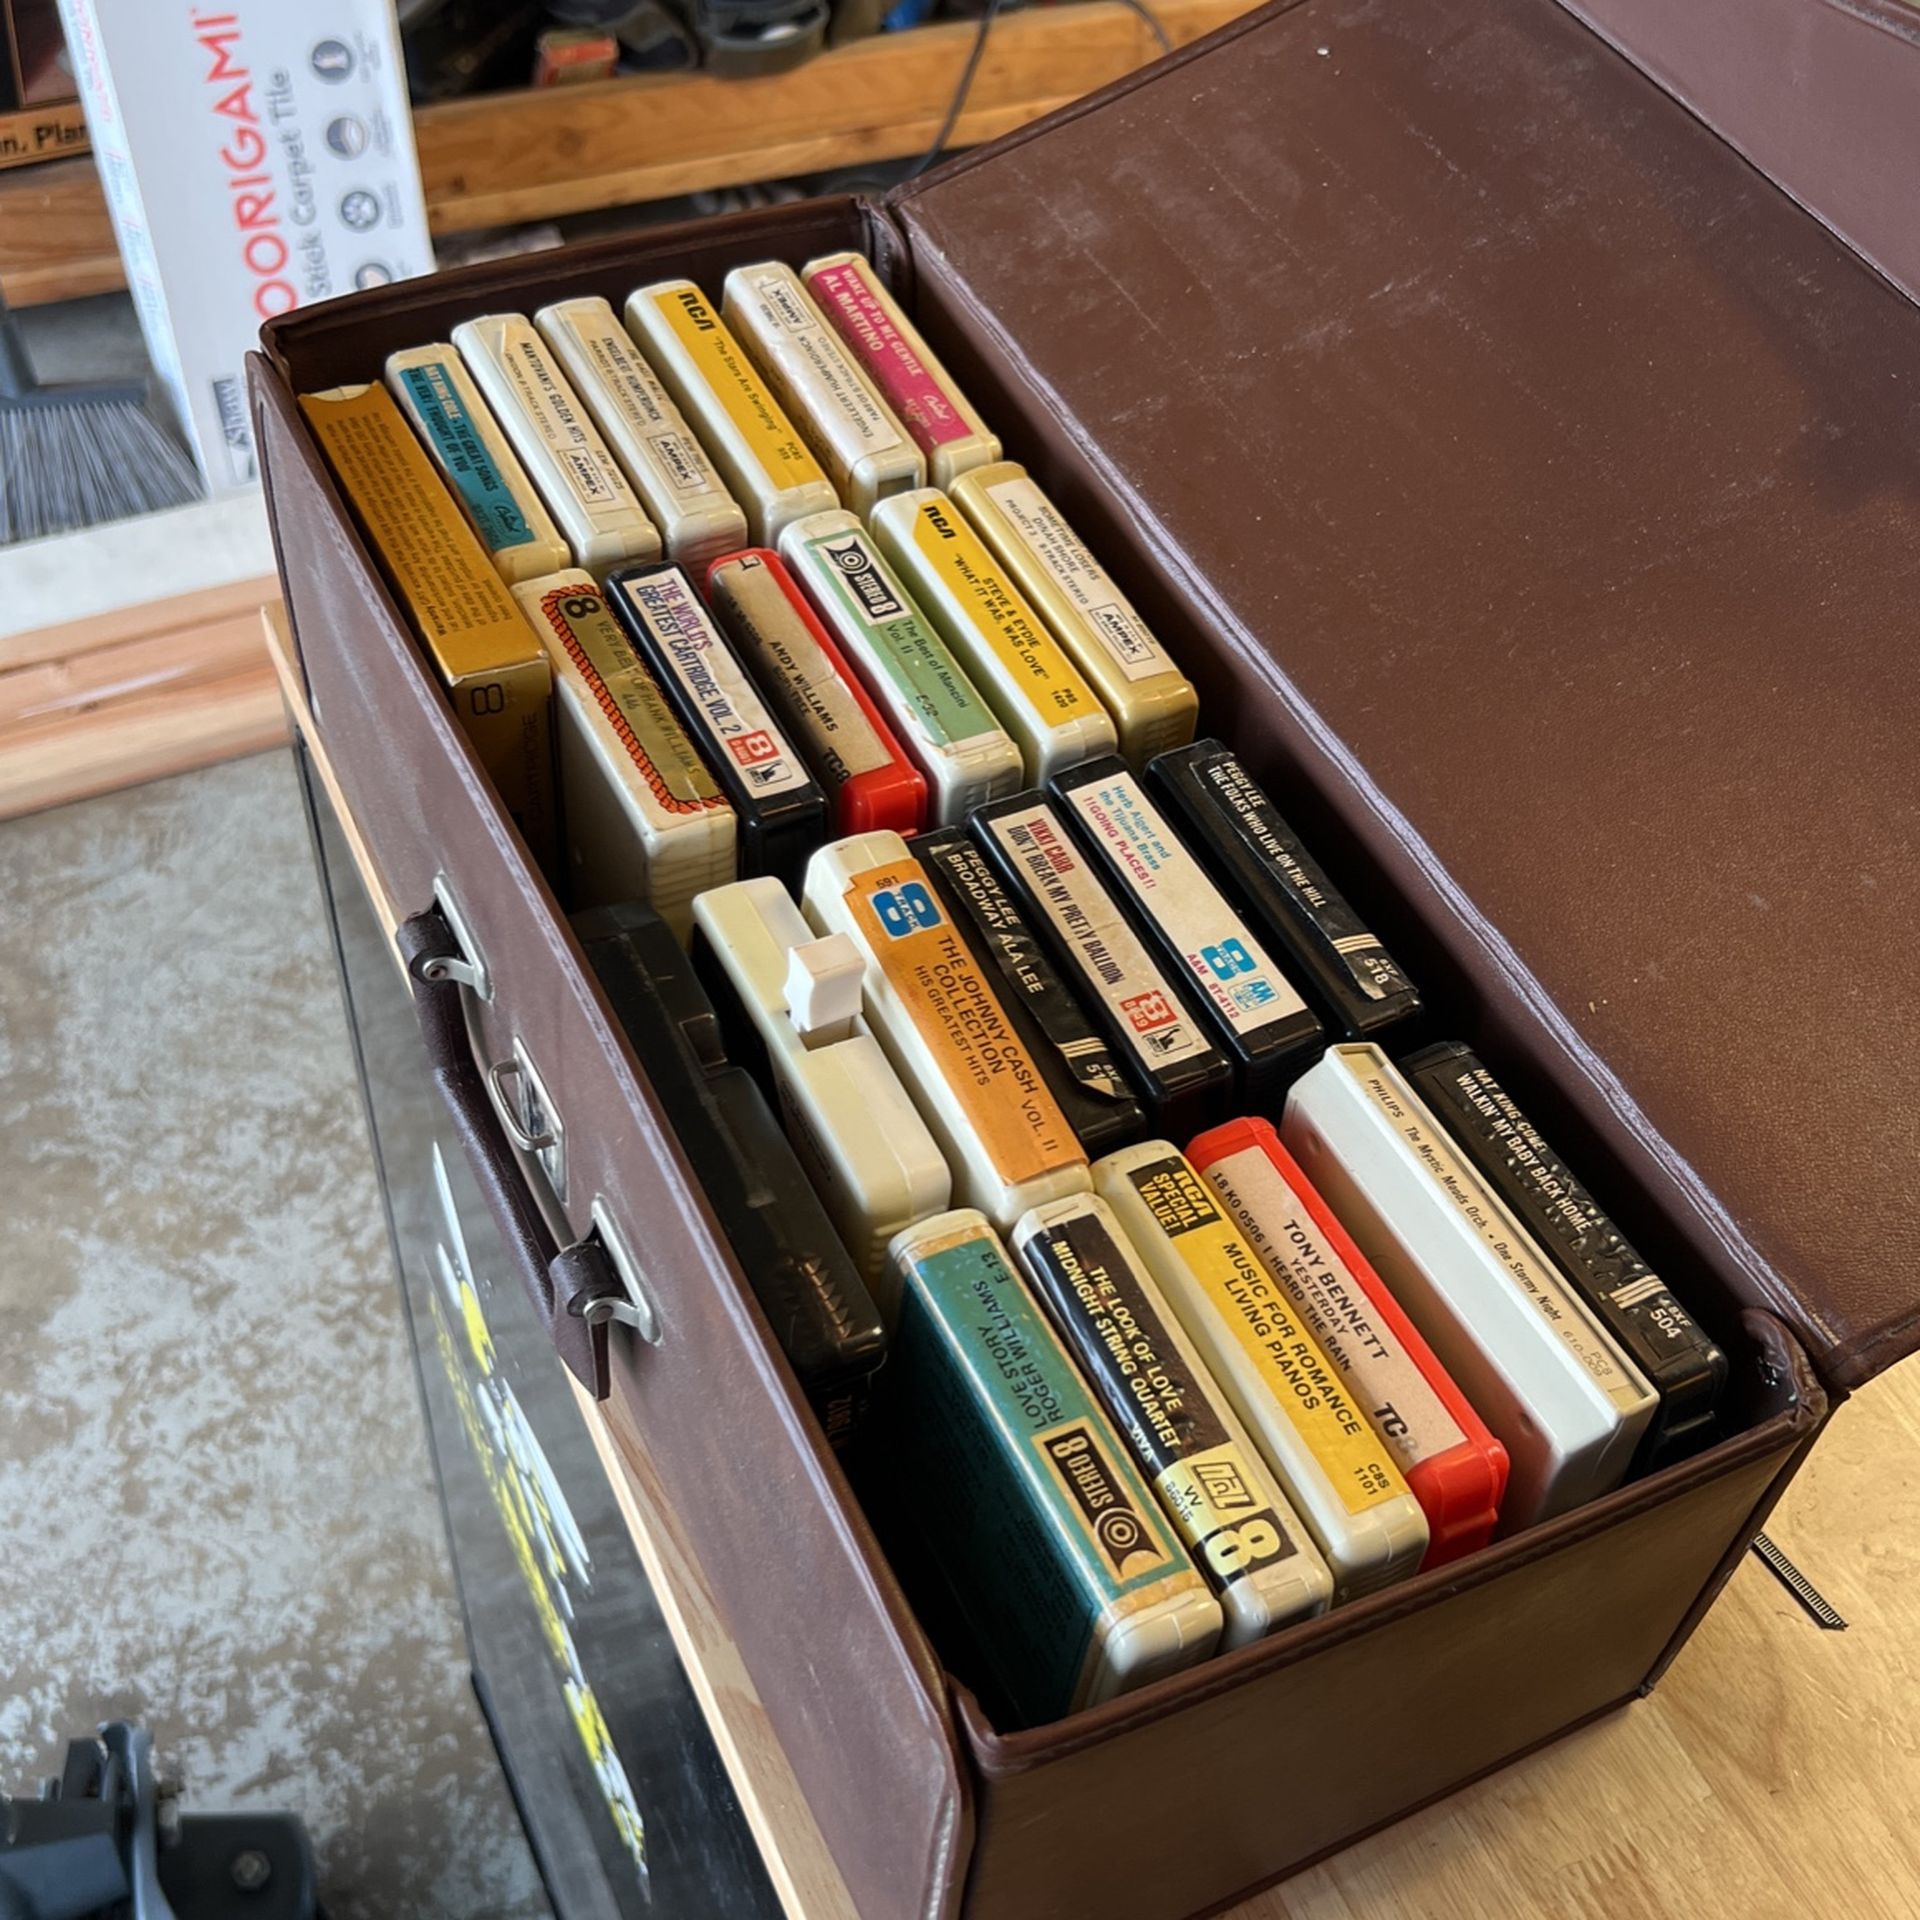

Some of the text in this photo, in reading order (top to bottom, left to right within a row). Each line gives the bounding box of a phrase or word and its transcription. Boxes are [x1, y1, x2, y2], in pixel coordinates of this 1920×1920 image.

[264, 69, 292, 124] Tile
[284, 130, 316, 227] Carpet
[677, 290, 716, 332] RCA
[772, 288, 801, 324] AMPEX
[821, 273, 886, 351] AL MARTINO
[840, 269, 866, 295] WAKE
[859, 296, 876, 310] UP
[869, 311, 885, 323] TO
[722, 355, 743, 377] Stars
[737, 377, 753, 392] Are
[548, 393, 574, 423] GOLDEN
[566, 426, 587, 444] HITS
[570, 456, 600, 494] AMPEX
[660, 441, 691, 479] AMPEX
[923, 505, 957, 540] RCA
[1031, 517, 1059, 544] DINAH
[1052, 545, 1081, 573] SHORE
[1061, 575, 1089, 604] STEREO
[1069, 548, 1101, 580] LOSERS
[565, 598, 598, 619] 8
[634, 583, 684, 639] GREATEST
[655, 579, 715, 652] THE WORLD'S
[851, 572, 898, 615] STEREO 8
[973, 586, 988, 597] IT
[1001, 624, 1025, 648] WAS
[982, 576, 1040, 648] STEVE & EYDIE
[1102, 612, 1140, 654] AMPEX
[596, 620, 621, 649] VERY
[629, 676, 648, 692] OF
[640, 693, 667, 723] HANK
[768, 640, 838, 731] ANDY WILLIAMS
[900, 619, 970, 708] The Best of Mancini
[704, 698, 736, 725] VOL.
[718, 722, 743, 736] 2
[746, 733, 771, 757] 8
[1221, 761, 1265, 807] PEGGY LEE
[1026, 818, 1075, 874] VIKKI CARR
[1097, 790, 1163, 871] the Tijuana Brass
[1111, 785, 1135, 808] Herb
[1150, 839, 1171, 858] and
[1205, 765, 1327, 907] THE FOLKS WHO LIVE ON THE HILL
[963, 849, 1021, 924] PEGGY LEE
[1006, 824, 1125, 985] DON'T BREAK MY BALLOON
[946, 853, 1045, 993] BROADWAY ALA LEE
[1185, 952, 1208, 975] A&M
[1200, 937, 1257, 981] 8
[1359, 957, 1392, 984] 518
[913, 965, 991, 1086] HIS GREATEST HITS
[931, 963, 1006, 1074] COLLECTION
[936, 935, 1058, 1151] THE JOHNNY CASH VOL. II
[1365, 1080, 1407, 1118] PHILIPS
[1471, 1067, 1547, 1151] NAT KING COLE
[1401, 1126, 1424, 1141] The
[1412, 1144, 1449, 1173] Mystic
[1454, 1073, 1593, 1233] WALKIN' MY BABY BACK HOME
[1138, 1181, 1182, 1230] VALUE!
[1153, 1172, 1200, 1227] SPECIAL
[1173, 1170, 1216, 1218] RCA
[1211, 1171, 1266, 1243] 18 0506
[1439, 1175, 1473, 1204] Moods
[1493, 1241, 1516, 1260] One
[1507, 1262, 1542, 1294] Stormy
[1267, 1255, 1307, 1301] HEARD
[1300, 1304, 1327, 1332] THE
[1322, 1336, 1354, 1372] RAIN
[1280, 1219, 1389, 1361] TONY BENNETT
[1287, 1258, 1349, 1336] YESTERDAY
[1533, 1295, 1564, 1322] Night
[970, 1280, 1065, 1421] ROGER WILLIAMS
[1049, 1239, 1182, 1450] MIDNIGHT STRING QUARTET
[1087, 1266, 1184, 1412] THE LOOK OF LOVE
[1221, 1242, 1362, 1435] MUSIC FOR ROMANCE
[1223, 1278, 1321, 1410] LIVING PIANOS
[1647, 1308, 1683, 1339] 504
[976, 1323, 1049, 1427] LOVE STORY
[1129, 1420, 1155, 1462] VIVA
[1050, 1434, 1116, 1508] STEREO 8
[1182, 1485, 1203, 1508] VV
[1352, 1466, 1378, 1495] 1101
[1365, 1462, 1391, 1489] C8S
[1205, 1516, 1281, 1577] 8
